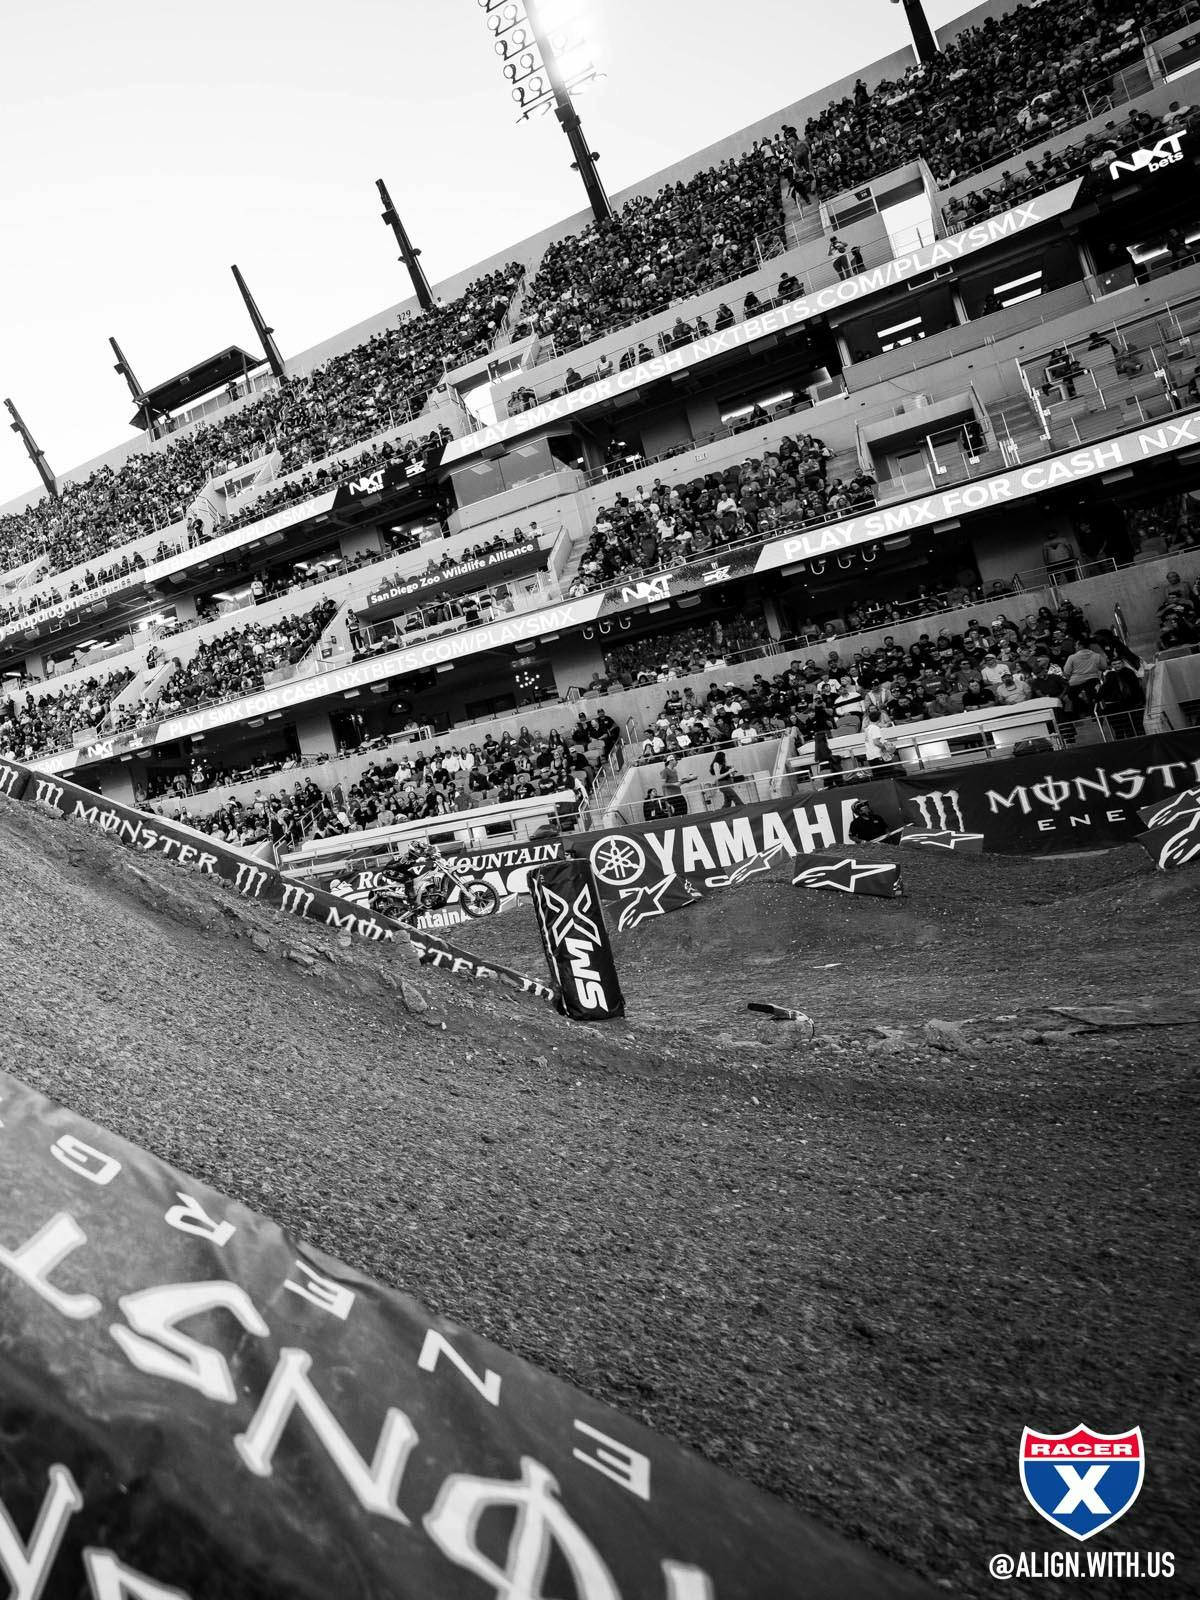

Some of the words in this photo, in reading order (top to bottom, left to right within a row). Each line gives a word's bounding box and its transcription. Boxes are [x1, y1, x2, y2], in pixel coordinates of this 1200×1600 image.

[1109, 130, 1187, 180] NXT
[1149, 149, 1185, 173] bets
[460, 422, 508, 451] PLAY
[515, 402, 563, 428] SMX
[566, 380, 611, 411] FOR
[617, 355, 684, 389] CASH
[691, 202, 1042, 357] NXTBETS.COM/PLAYSMX
[783, 523, 856, 560] PLAY
[865, 504, 935, 537] SMX
[941, 478, 1011, 515] FOR
[1020, 443, 1123, 490] CASH
[370, 592, 390, 604] San
[390, 582, 418, 599] Diego
[419, 574, 441, 589] Zoo
[442, 560, 486, 579] Wildlife
[488, 543, 534, 566] Alliance
[621, 573, 673, 603] NXT
[7, 601, 79, 635] Snapdragon
[169, 712, 206, 736] PLAY
[209, 704, 244, 725] SMX
[248, 693, 279, 717] FOR
[282, 682, 330, 709] CASH
[73, 800, 218, 874] MONSTER
[1037, 807, 1135, 832] ENE
